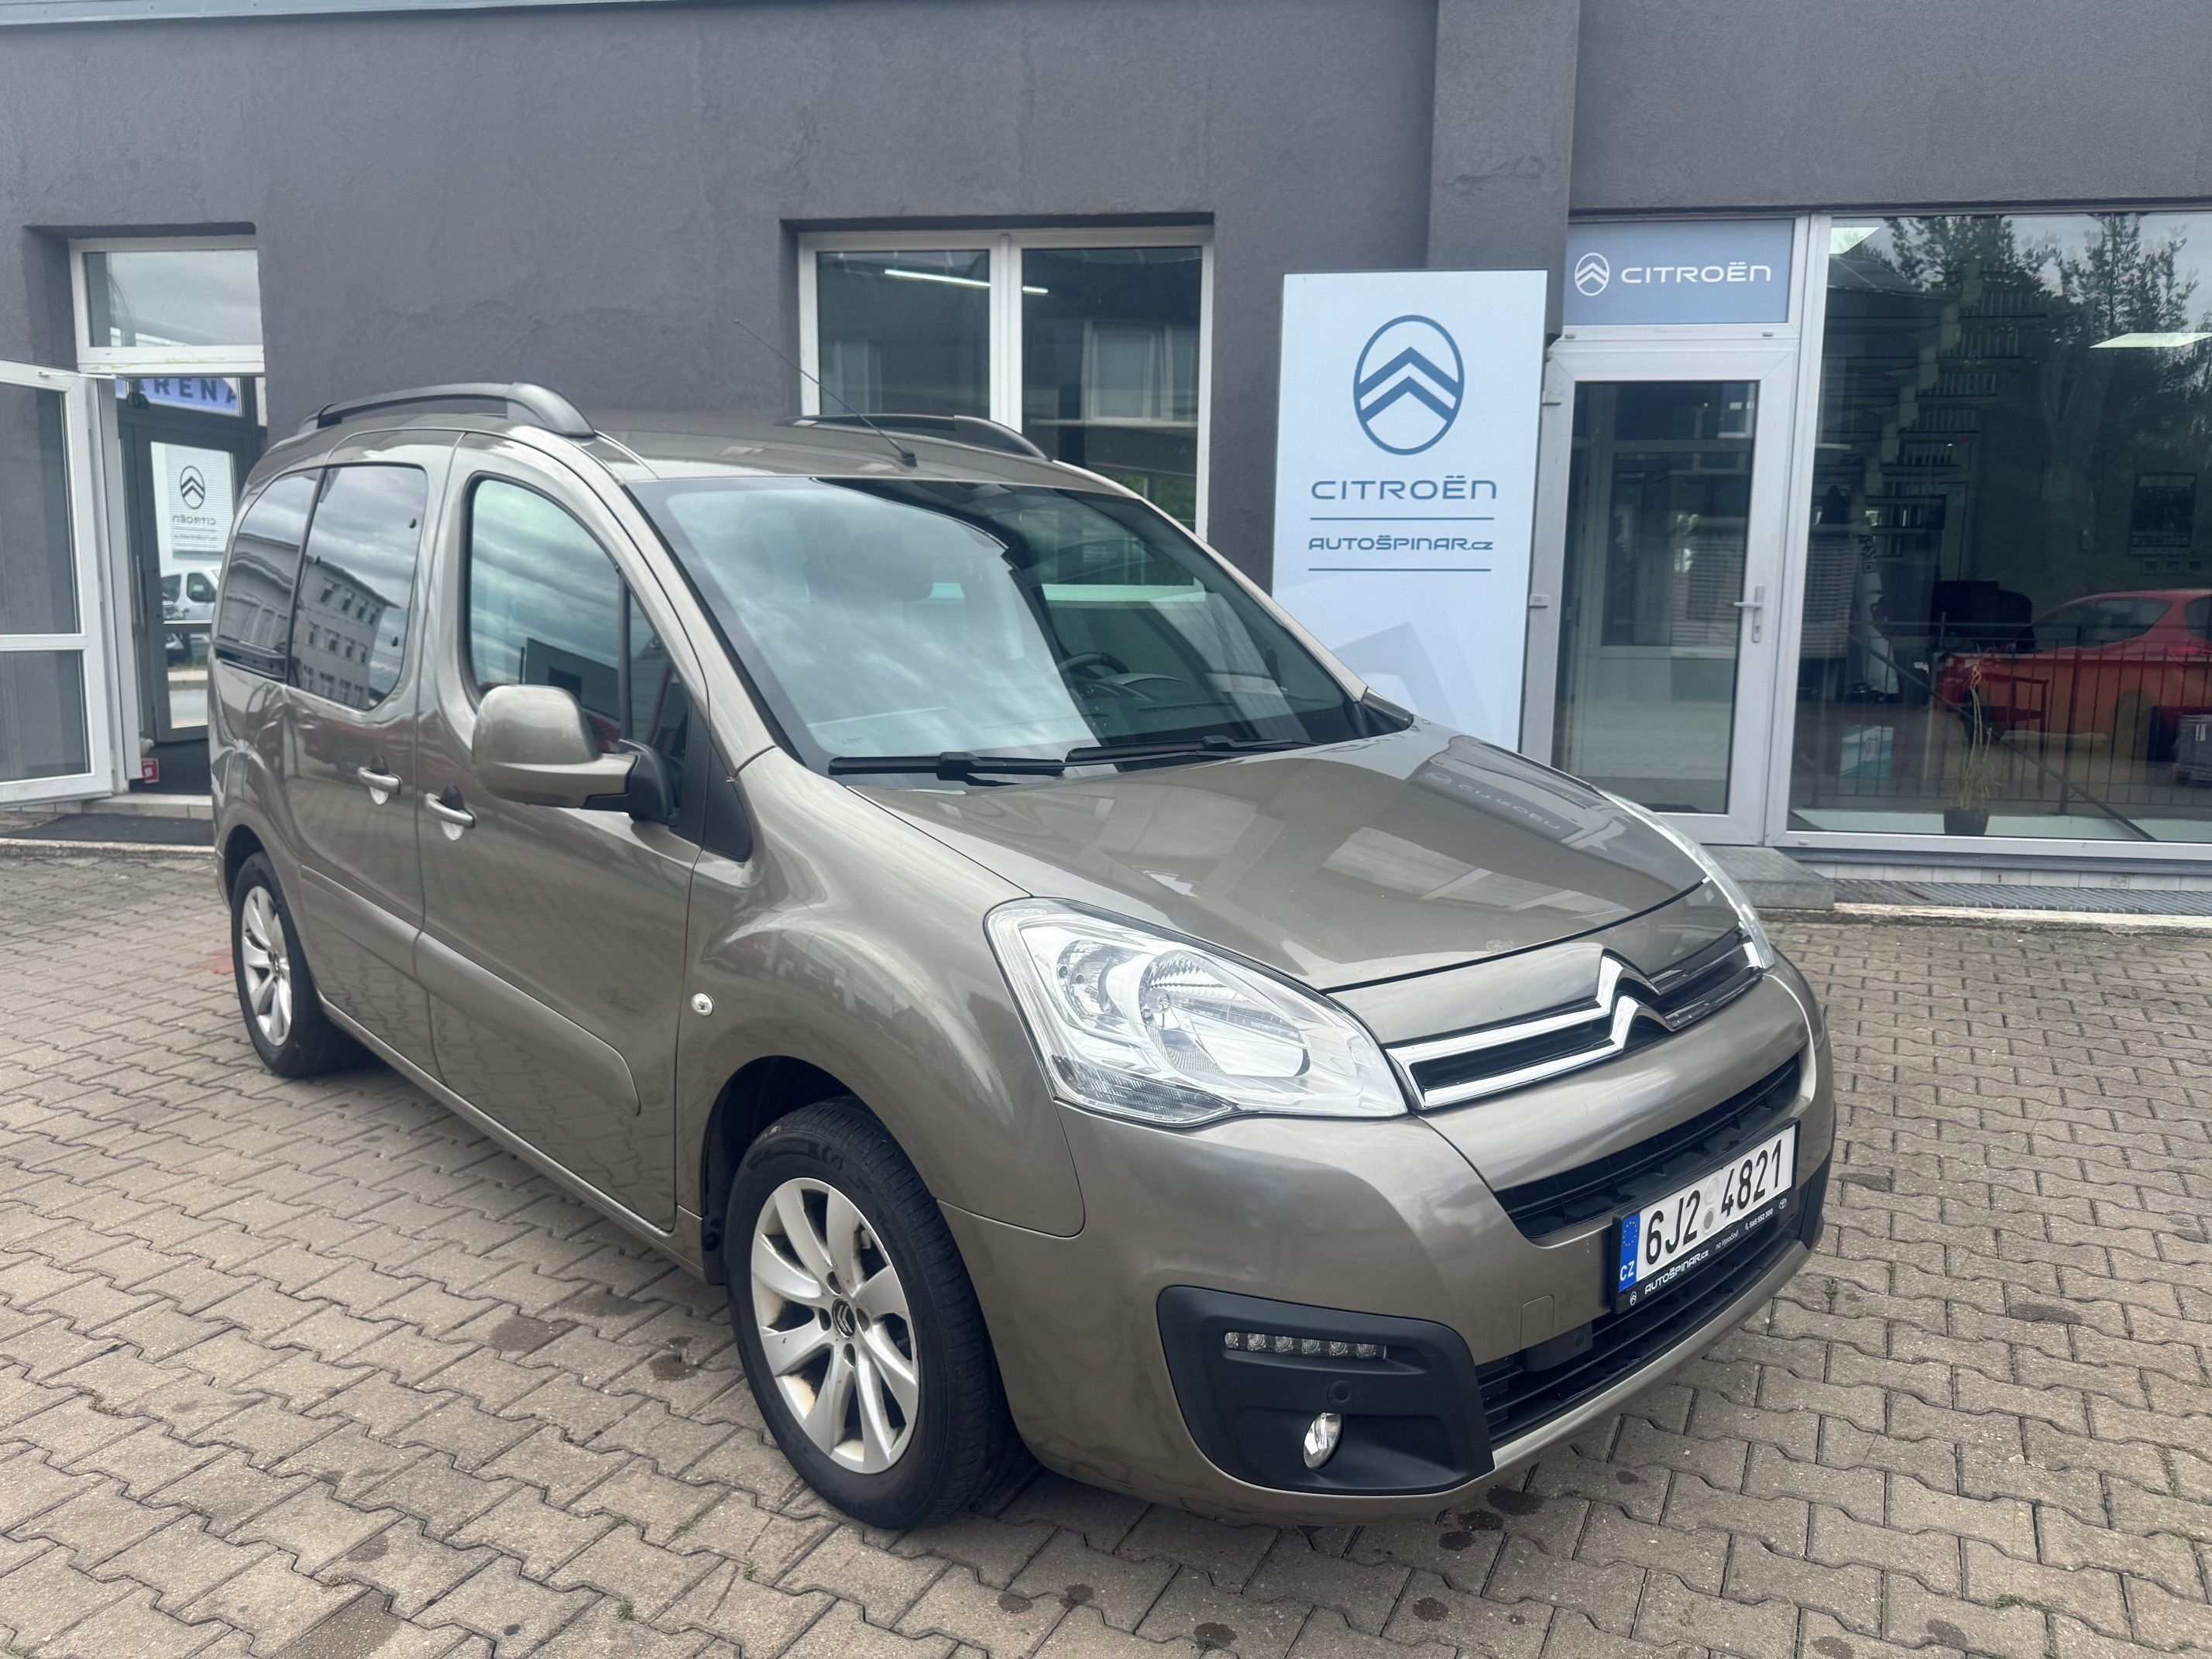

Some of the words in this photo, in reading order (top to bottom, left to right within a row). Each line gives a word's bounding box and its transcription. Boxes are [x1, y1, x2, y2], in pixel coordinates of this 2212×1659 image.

[1621, 262, 1771, 283] CITROËN
[1311, 476, 1496, 500] CITROËN
[1308, 535, 1493, 551] AUTOŠPINAR.cz
[1646, 1190, 1701, 1265] 6J2
[1721, 1139, 1782, 1217] 4821
[1620, 1260, 1635, 1281] CZ
